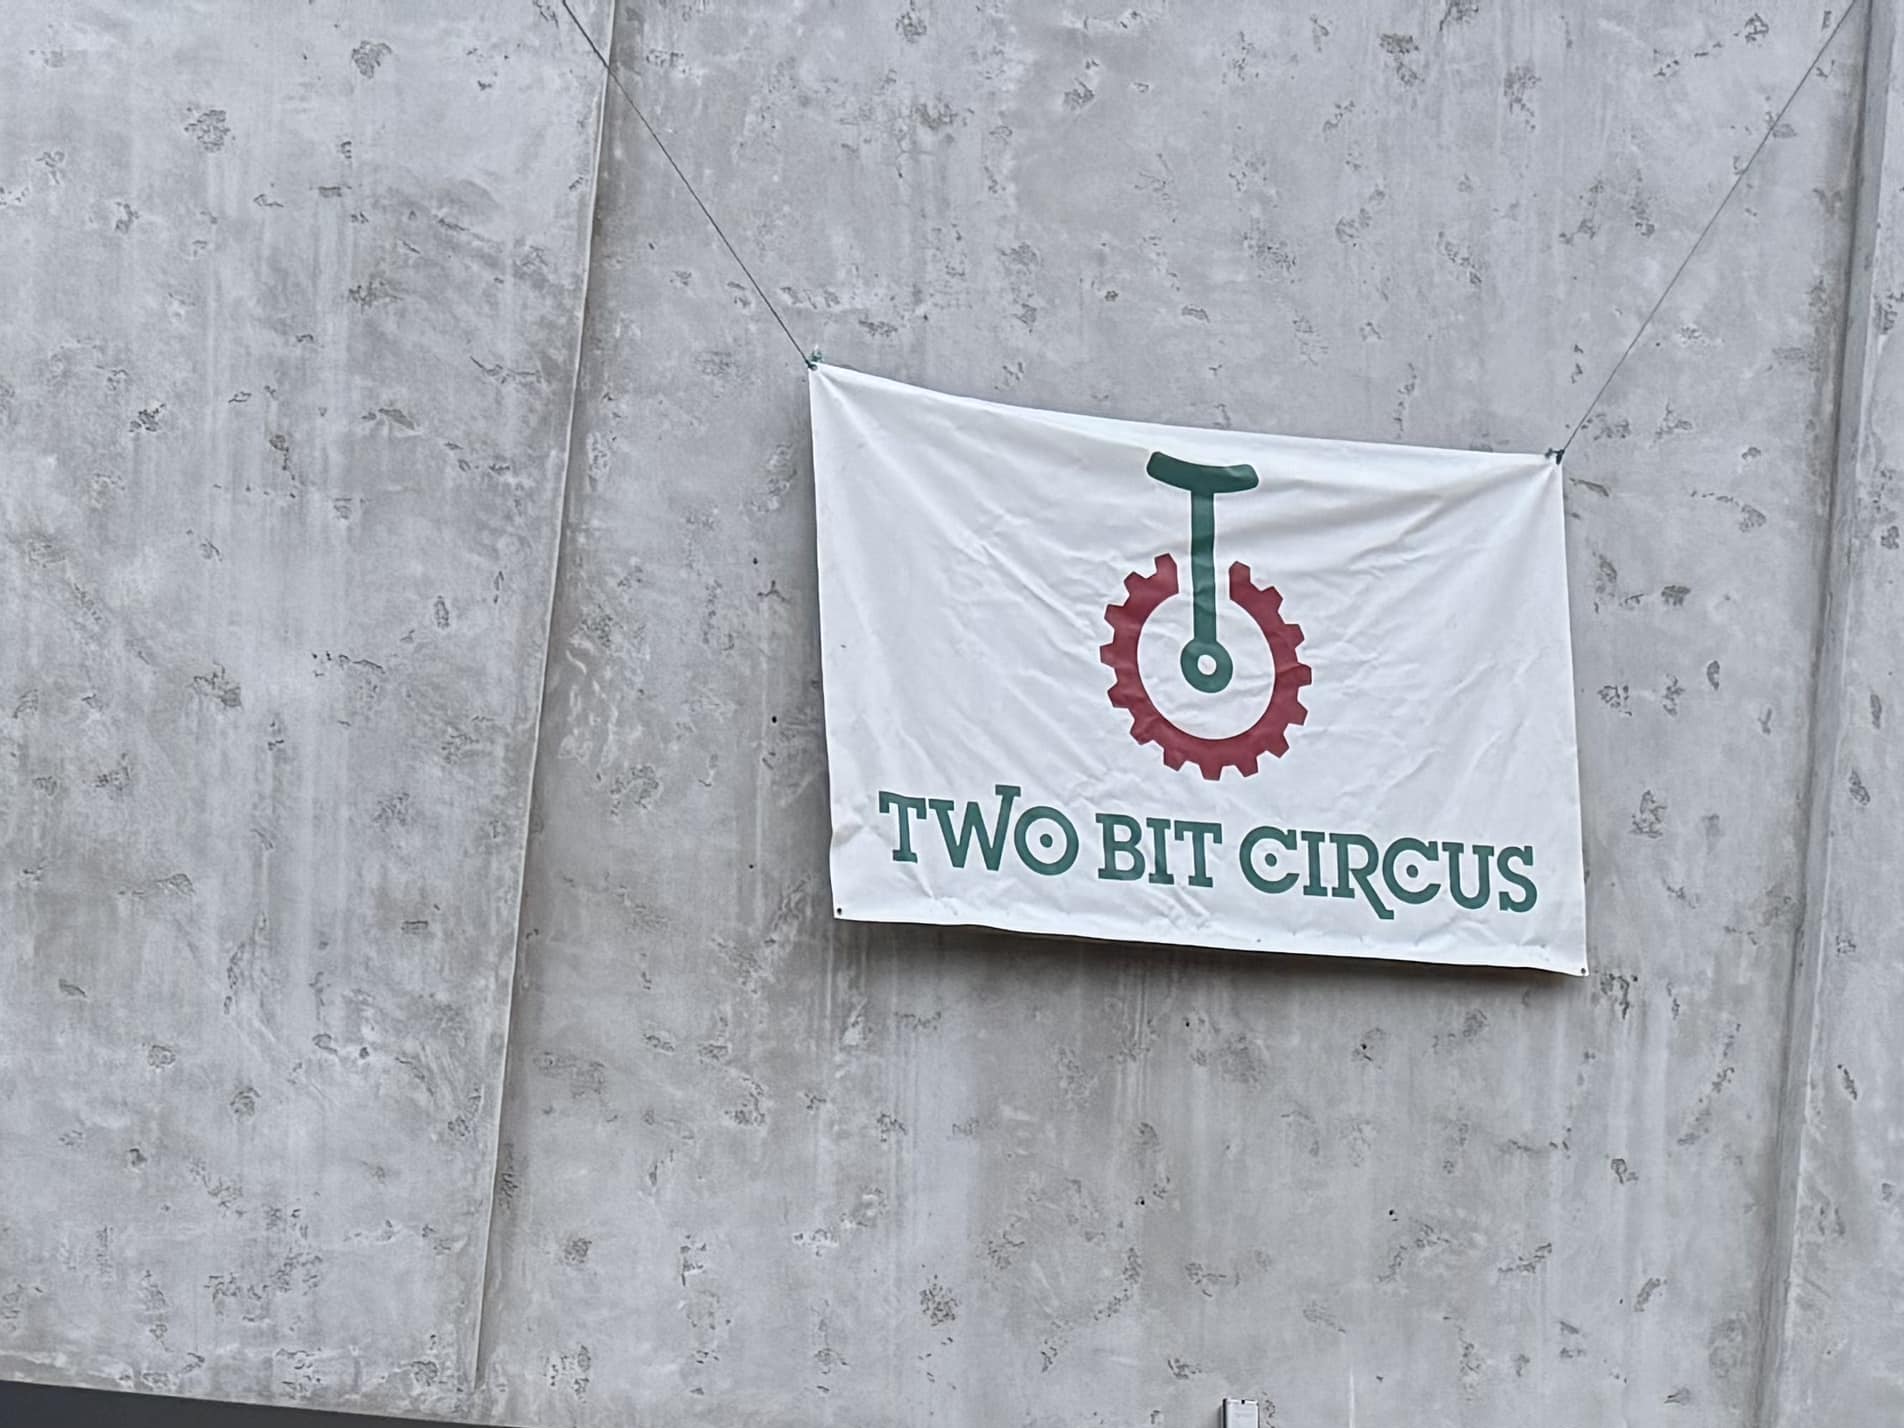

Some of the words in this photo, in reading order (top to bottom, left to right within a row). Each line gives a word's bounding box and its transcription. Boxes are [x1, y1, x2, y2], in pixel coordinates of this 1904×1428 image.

[879, 784, 1079, 876] TWO
[1097, 813, 1223, 887] BIT
[1239, 825, 1539, 920] CIRCUS
